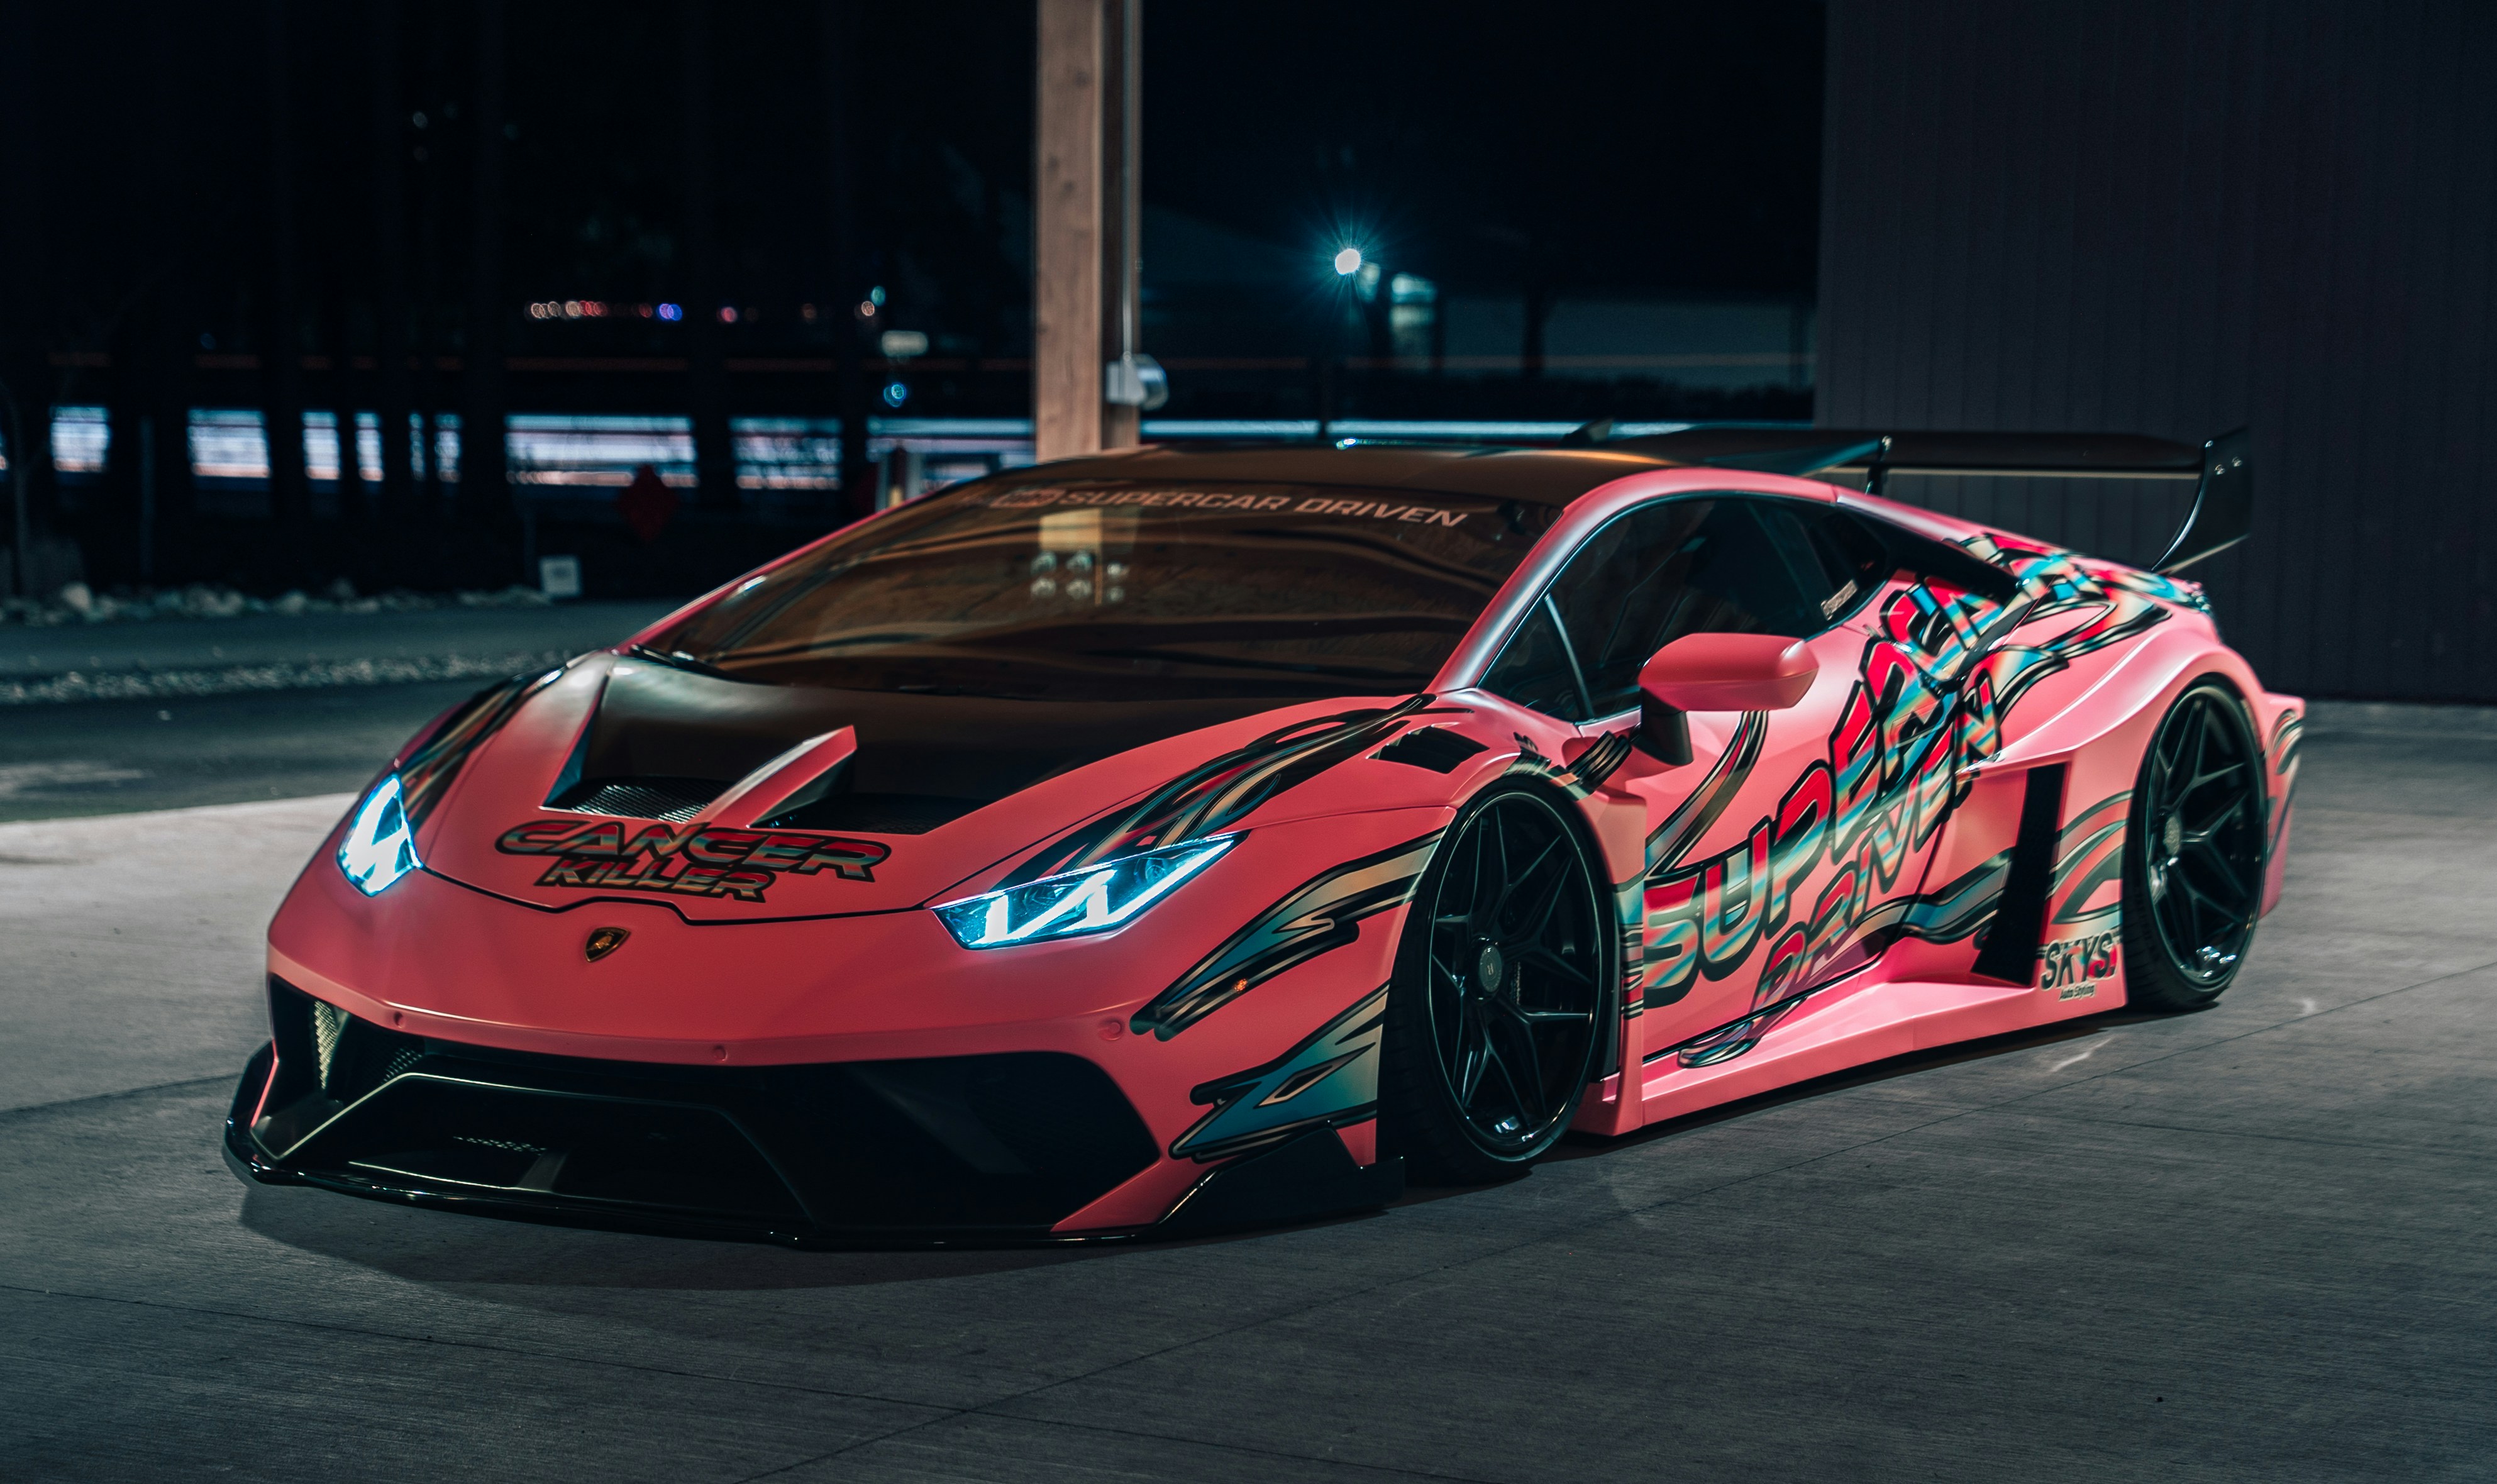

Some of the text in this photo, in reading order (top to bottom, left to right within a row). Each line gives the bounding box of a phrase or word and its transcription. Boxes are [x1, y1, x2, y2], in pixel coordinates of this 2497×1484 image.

[1056, 489, 1292, 512] SUPERCAR
[1293, 497, 1469, 528] DRIVEN
[495, 820, 892, 882] CANCER
[533, 856, 777, 903] KILLER
